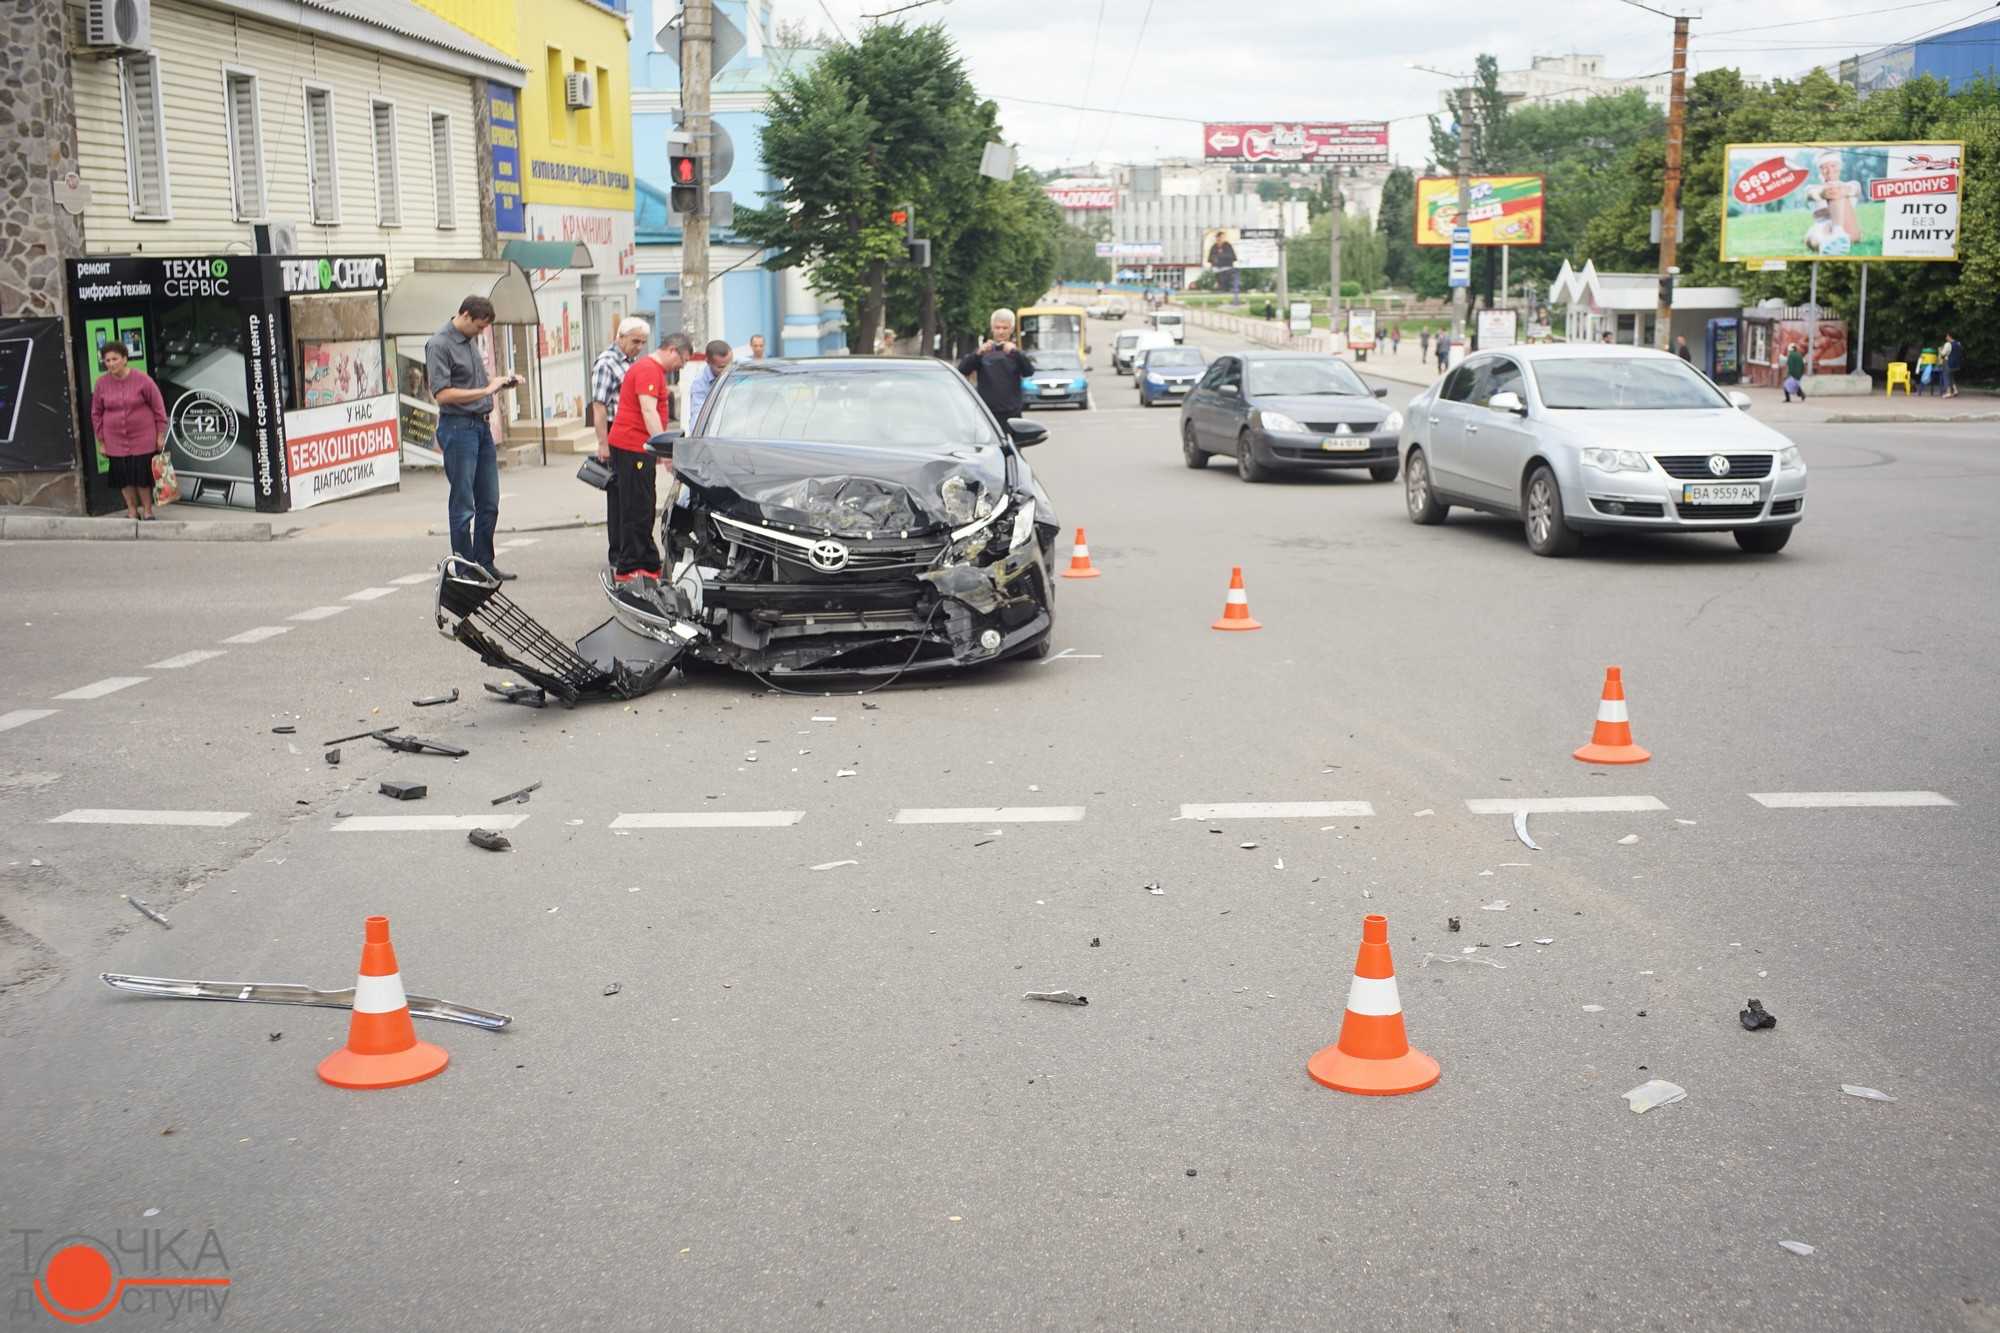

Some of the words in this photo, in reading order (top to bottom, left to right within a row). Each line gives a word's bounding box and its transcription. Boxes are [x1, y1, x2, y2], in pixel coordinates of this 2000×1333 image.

[1739, 170, 1770, 193] 969
[1756, 186, 1765, 196] 3
[1877, 177, 1950, 197] ПРОПОНУЄ
[1901, 203, 1948, 214] ЛІТО
[1912, 217, 1936, 226] БЕЗ
[1891, 229, 1955, 240] ЛІМІТУ
[77, 262, 111, 278] ремонт
[162, 259, 228, 278] ТЕХНО
[79, 281, 121, 301] цифрової
[122, 280, 151, 296] техніки
[164, 279, 230, 297] СЕРВІС
[249, 314, 261, 356] центр
[268, 313, 276, 355] центр
[251, 358, 267, 426] сервісний
[346, 407, 353, 423] У
[355, 403, 373, 419] НАС
[290, 425, 394, 472] БЕЗКОШТОВНА
[256, 427, 274, 496] офіційний
[313, 462, 375, 496] ДІАГНОСТИКА
[1712, 487, 1738, 499] 9559
